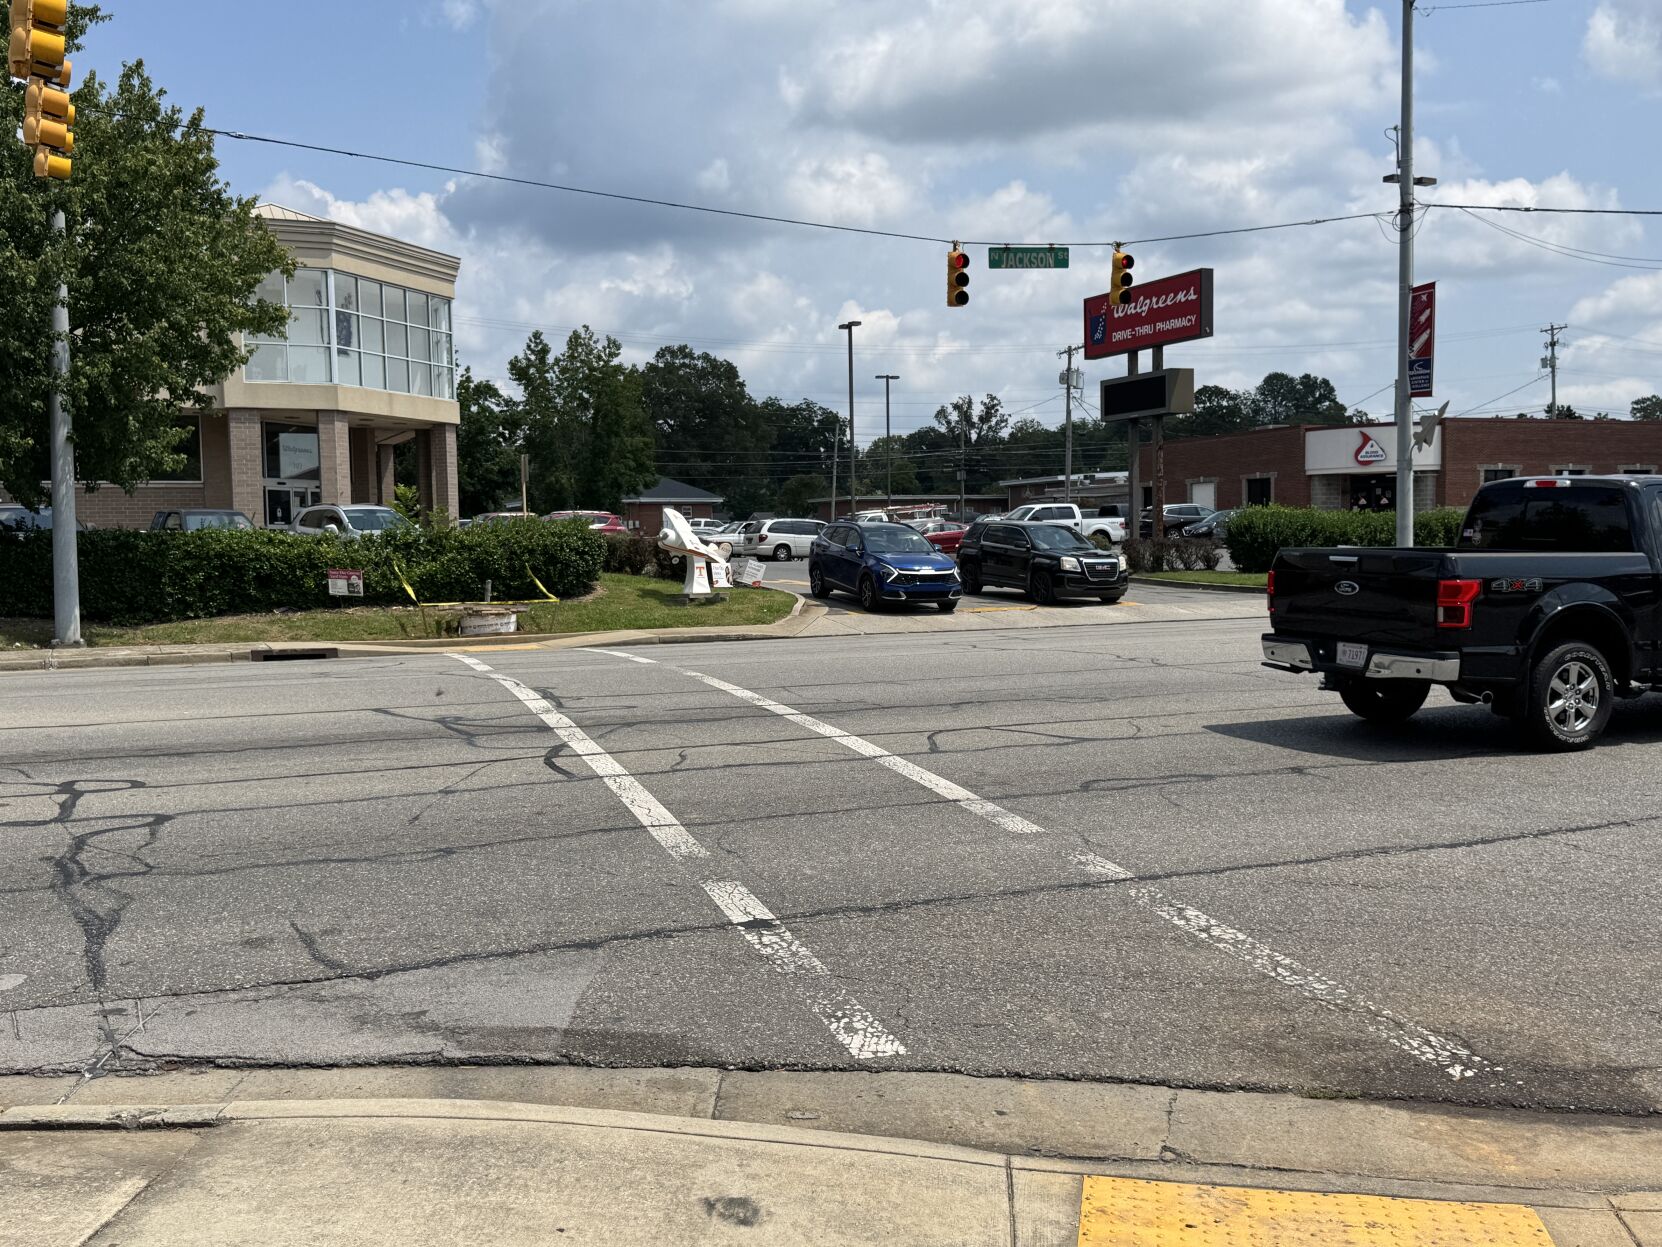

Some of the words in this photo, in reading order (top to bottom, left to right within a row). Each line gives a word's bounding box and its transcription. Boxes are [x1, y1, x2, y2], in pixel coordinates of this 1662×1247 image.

[990, 252, 999, 260] N
[1001, 252, 1055, 268] JACKSON
[1111, 286, 1198, 318] Walgreens
[1112, 323, 1154, 342] DRIVE-THRU
[1155, 314, 1197, 333] PHARMACY
[695, 566, 705, 577] T
